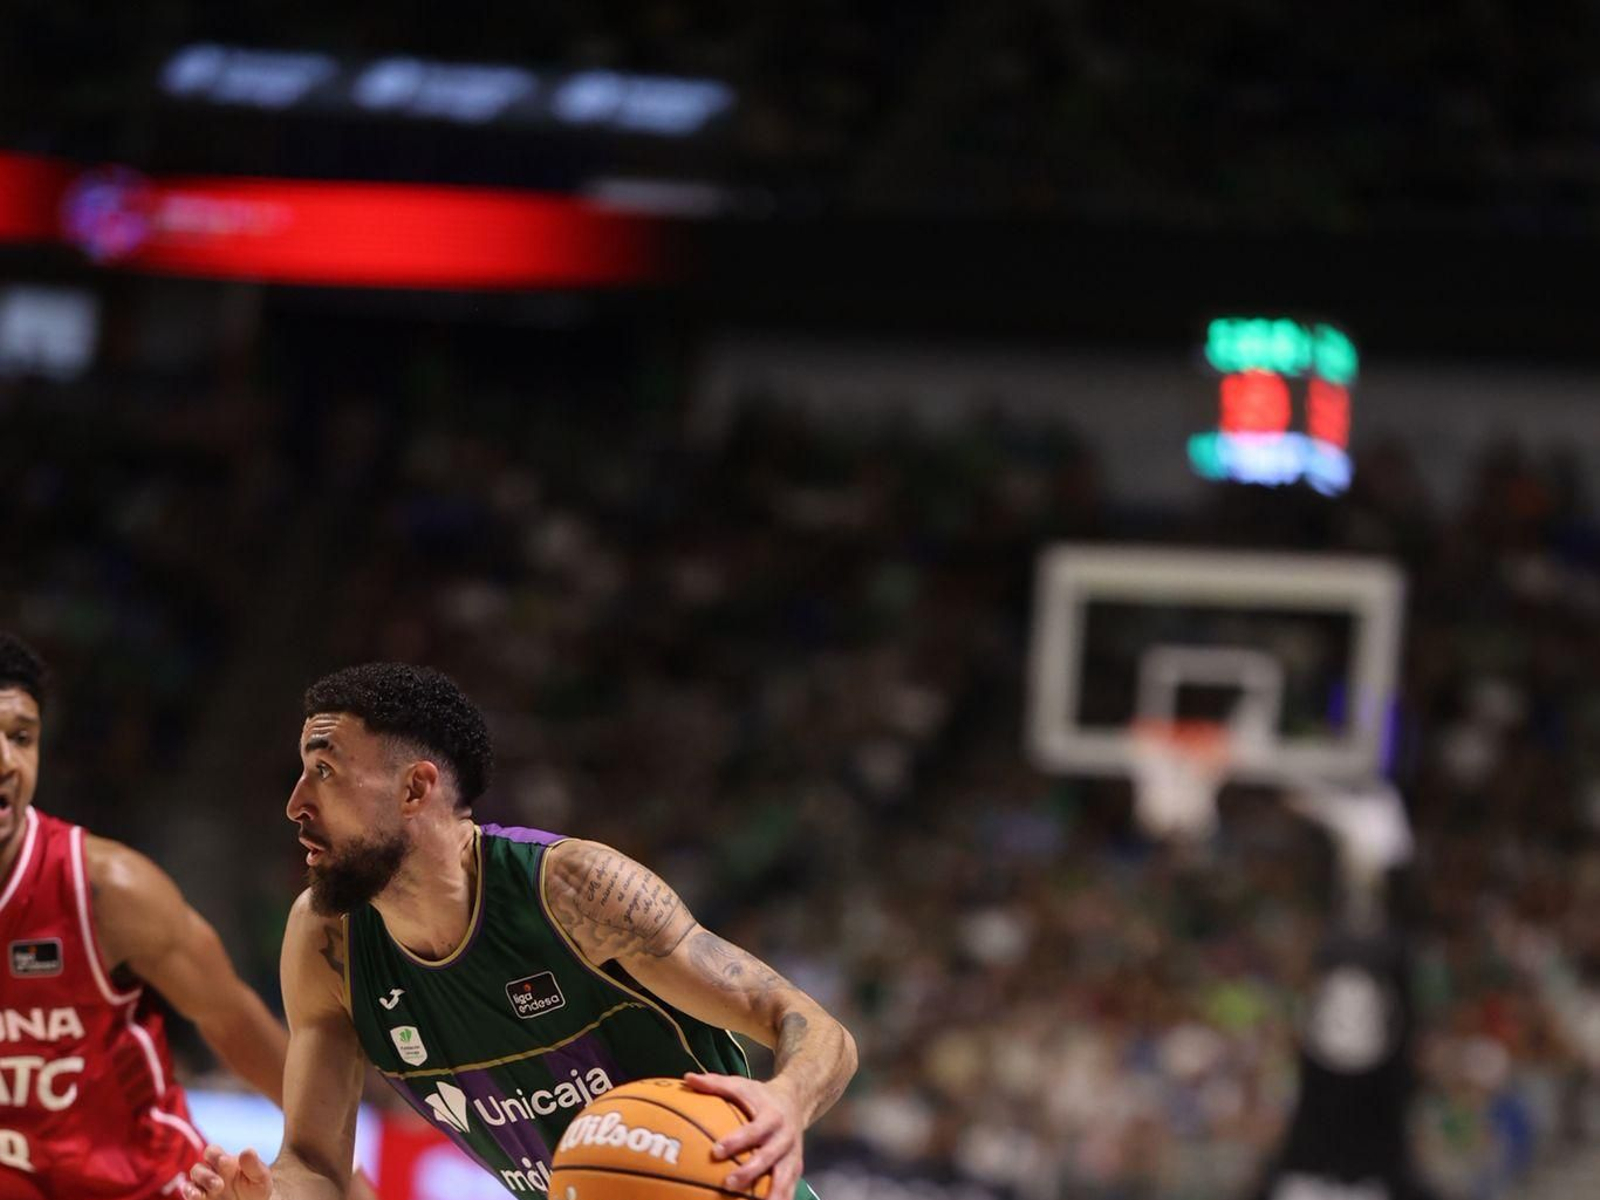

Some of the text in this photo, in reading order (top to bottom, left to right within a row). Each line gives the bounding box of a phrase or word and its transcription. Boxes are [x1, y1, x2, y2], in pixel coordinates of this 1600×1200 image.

[0, 1006, 86, 1043] NA
[518, 994, 561, 1013] endesa
[473, 1067, 614, 1127] Unicaja
[560, 1111, 682, 1165] Wilson
